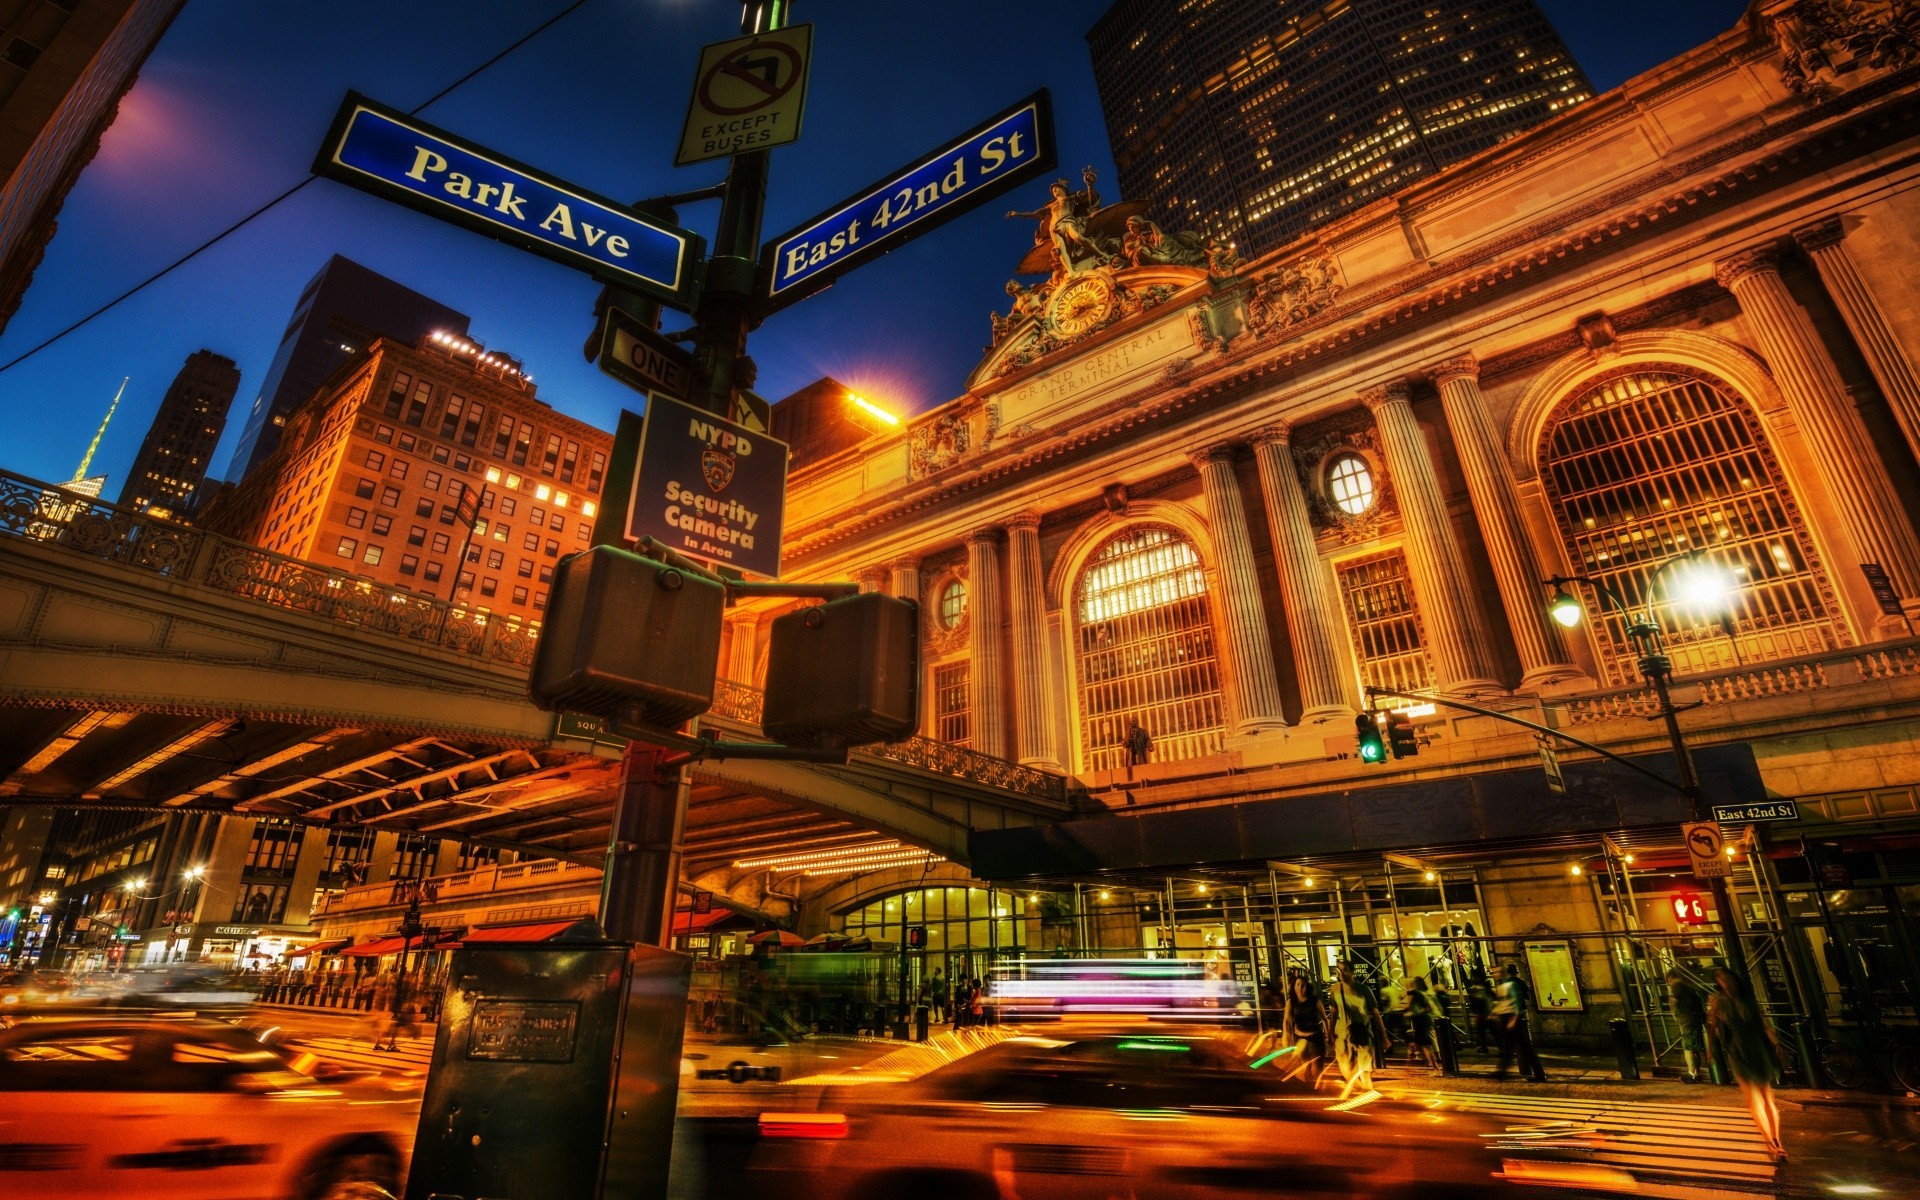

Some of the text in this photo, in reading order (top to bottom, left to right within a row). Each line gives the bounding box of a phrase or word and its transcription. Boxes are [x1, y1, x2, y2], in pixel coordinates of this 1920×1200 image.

[702, 112, 780, 138] EXCEPT
[704, 129, 771, 153] BUSES
[405, 145, 630, 258] Park Ave
[783, 130, 1025, 280] East 42nd St
[631, 343, 679, 389] ONE
[1017, 330, 1166, 401] GRAND CENTRAL
[1048, 358, 1134, 399] TERMINAL
[689, 418, 752, 456] NYPD
[664, 480, 759, 531] Security
[664, 505, 755, 550] Camera
[684, 535, 733, 559] In Area
[577, 721, 606, 734] SQUA
[1717, 805, 1793, 820] East 42nd St
[1698, 860, 1723, 868] EXCEPT
[1701, 867, 1724, 876] BUSES
[1692, 900, 1703, 917] 6
